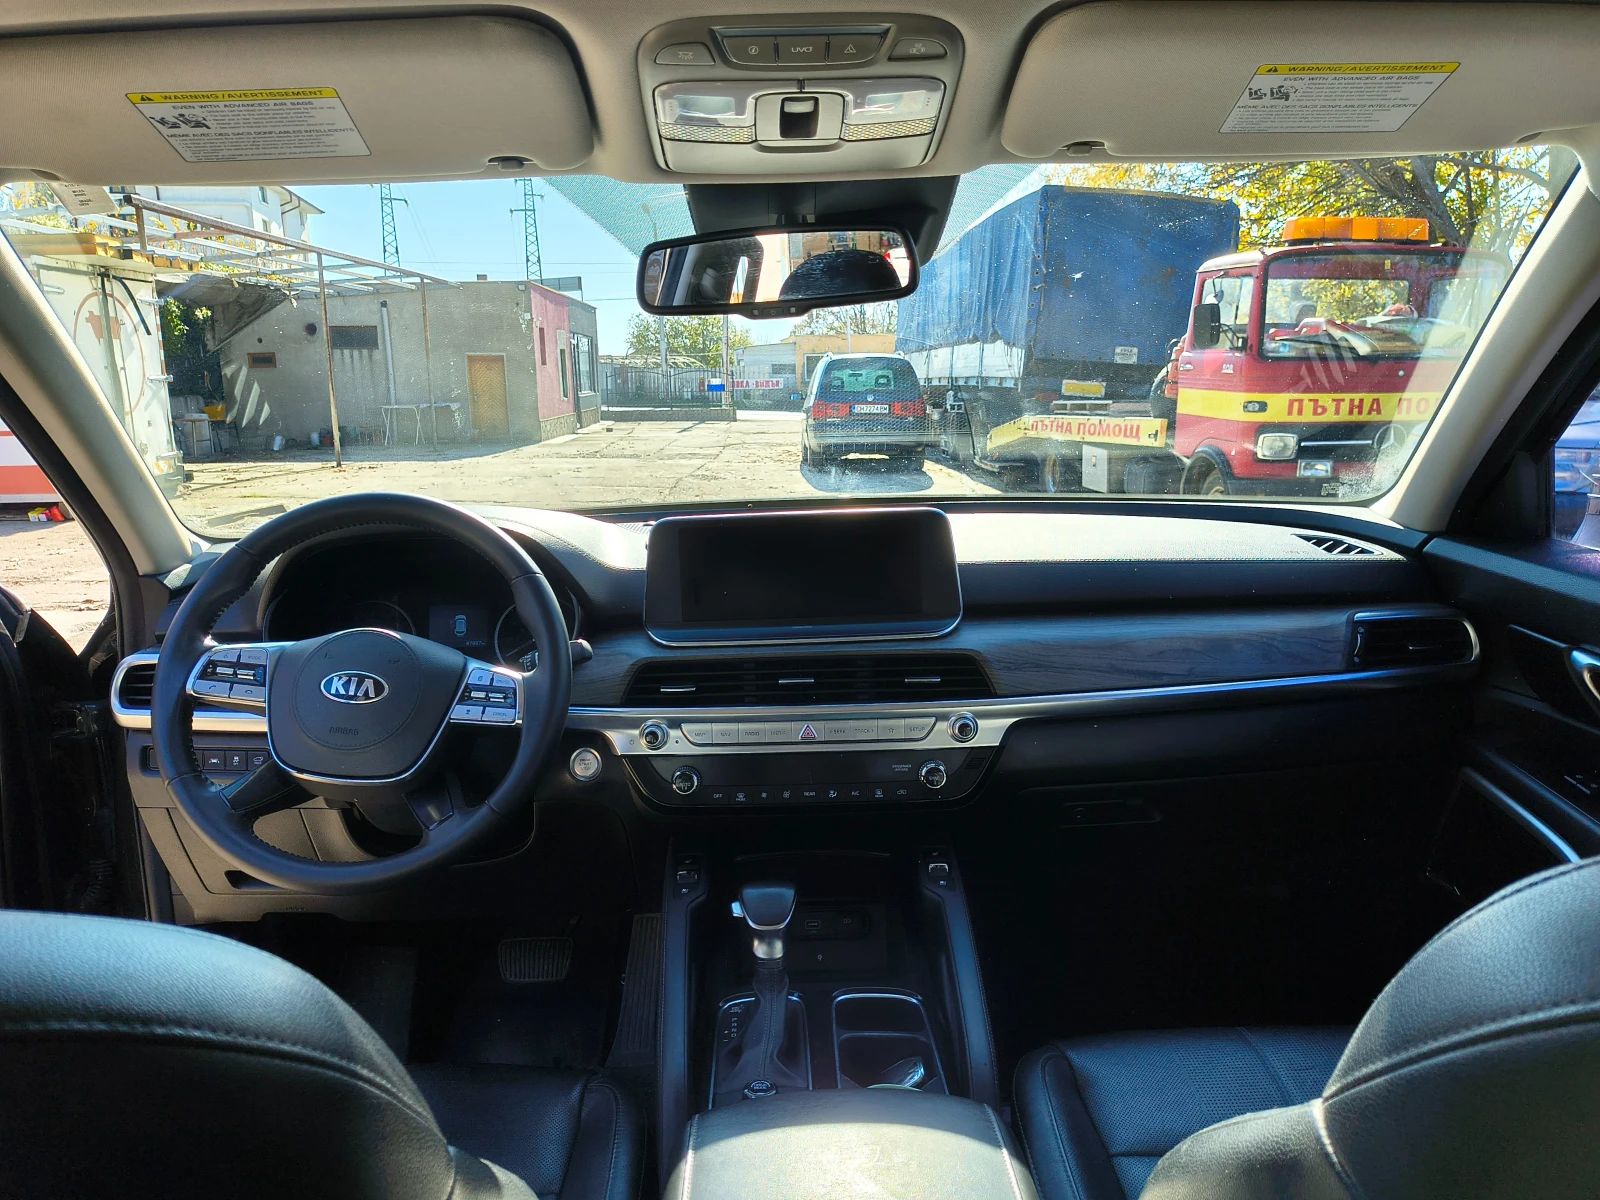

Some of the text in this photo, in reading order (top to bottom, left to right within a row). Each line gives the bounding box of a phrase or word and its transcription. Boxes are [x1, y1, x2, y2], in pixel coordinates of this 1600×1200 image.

[1286, 397, 1383, 417] ПЪТНА
[1030, 420, 1141, 442] ПЪТНА ПОМОЩ
[330, 676, 376, 698] KIA
